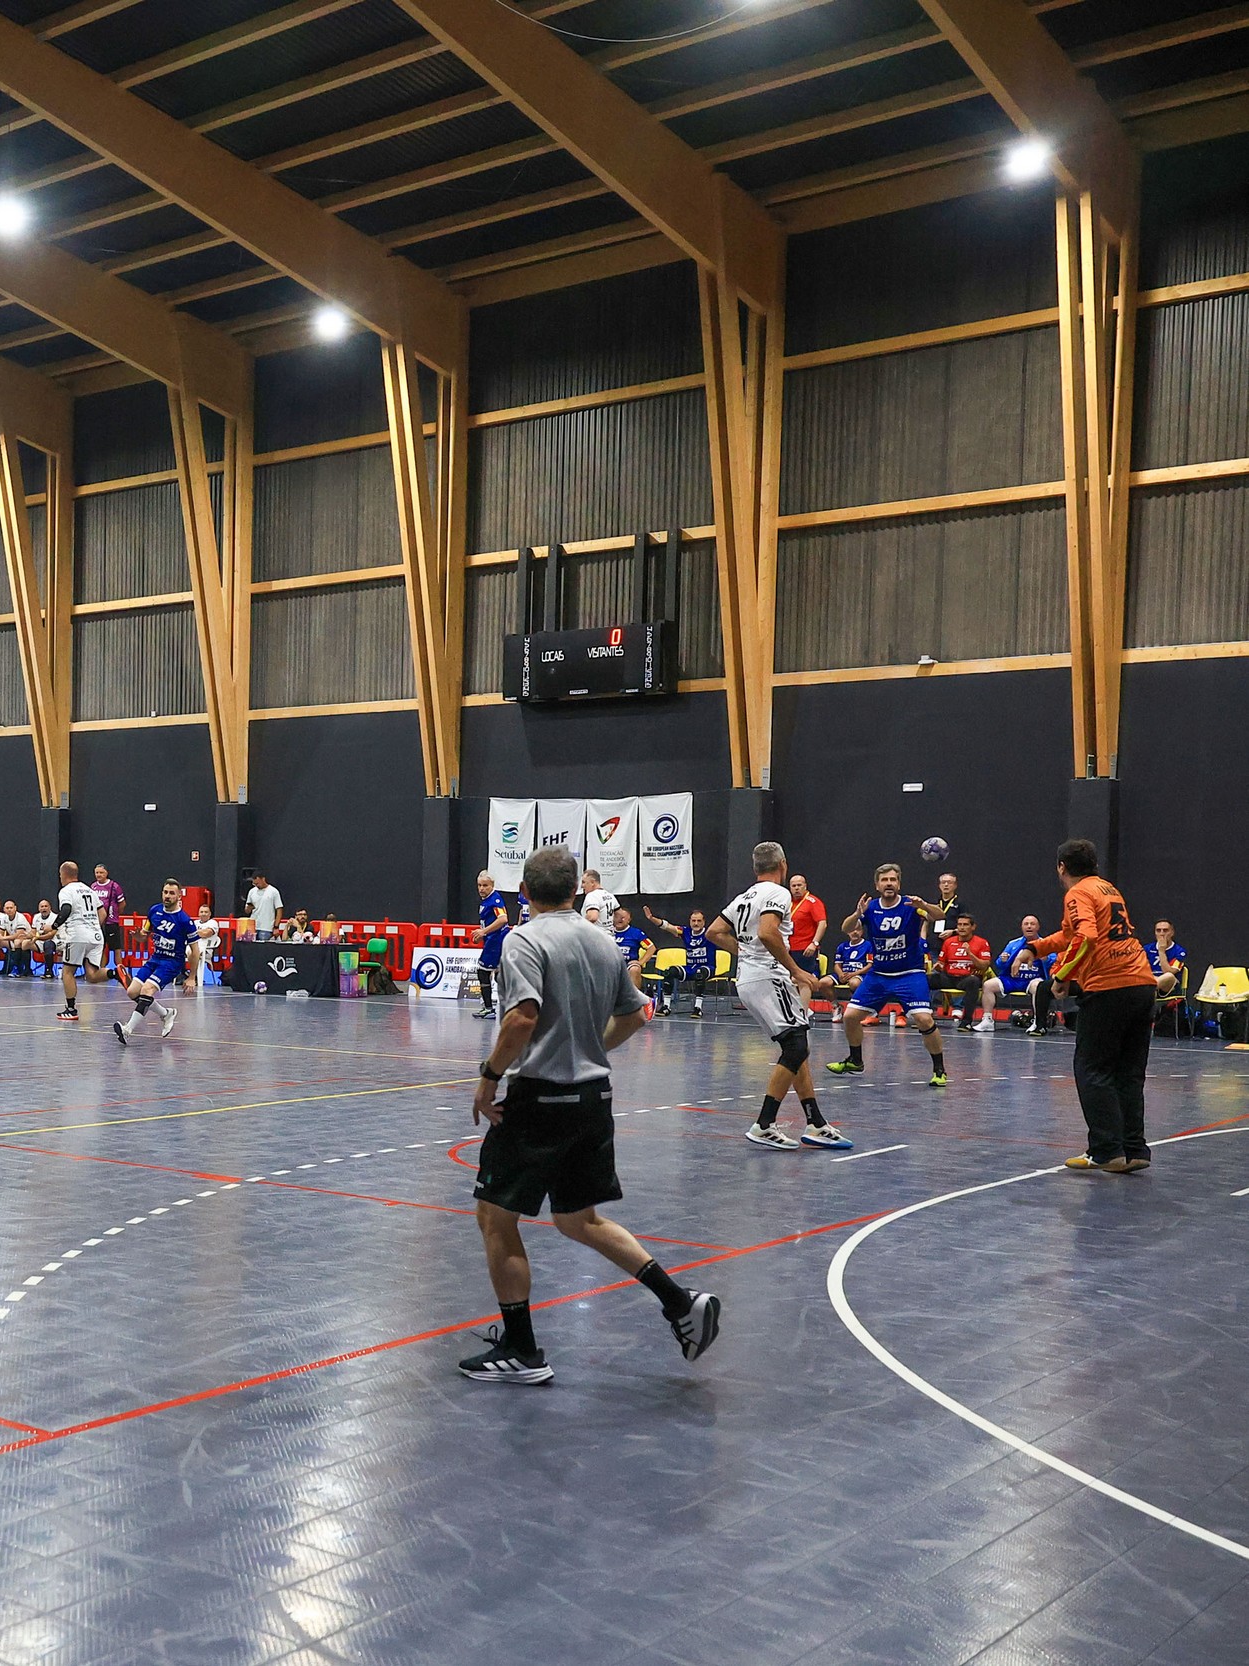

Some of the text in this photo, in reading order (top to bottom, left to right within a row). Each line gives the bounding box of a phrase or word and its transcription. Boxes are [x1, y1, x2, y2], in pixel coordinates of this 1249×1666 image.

[611, 628, 621, 645] 0
[541, 650, 565, 662] LOCAIS
[587, 645, 624, 658] VISITANTES
[543, 831, 569, 846] EHF
[494, 848, 526, 860] Setúbal
[82, 895, 94, 911] 17
[157, 920, 175, 933] 24
[880, 916, 902, 931] 59
